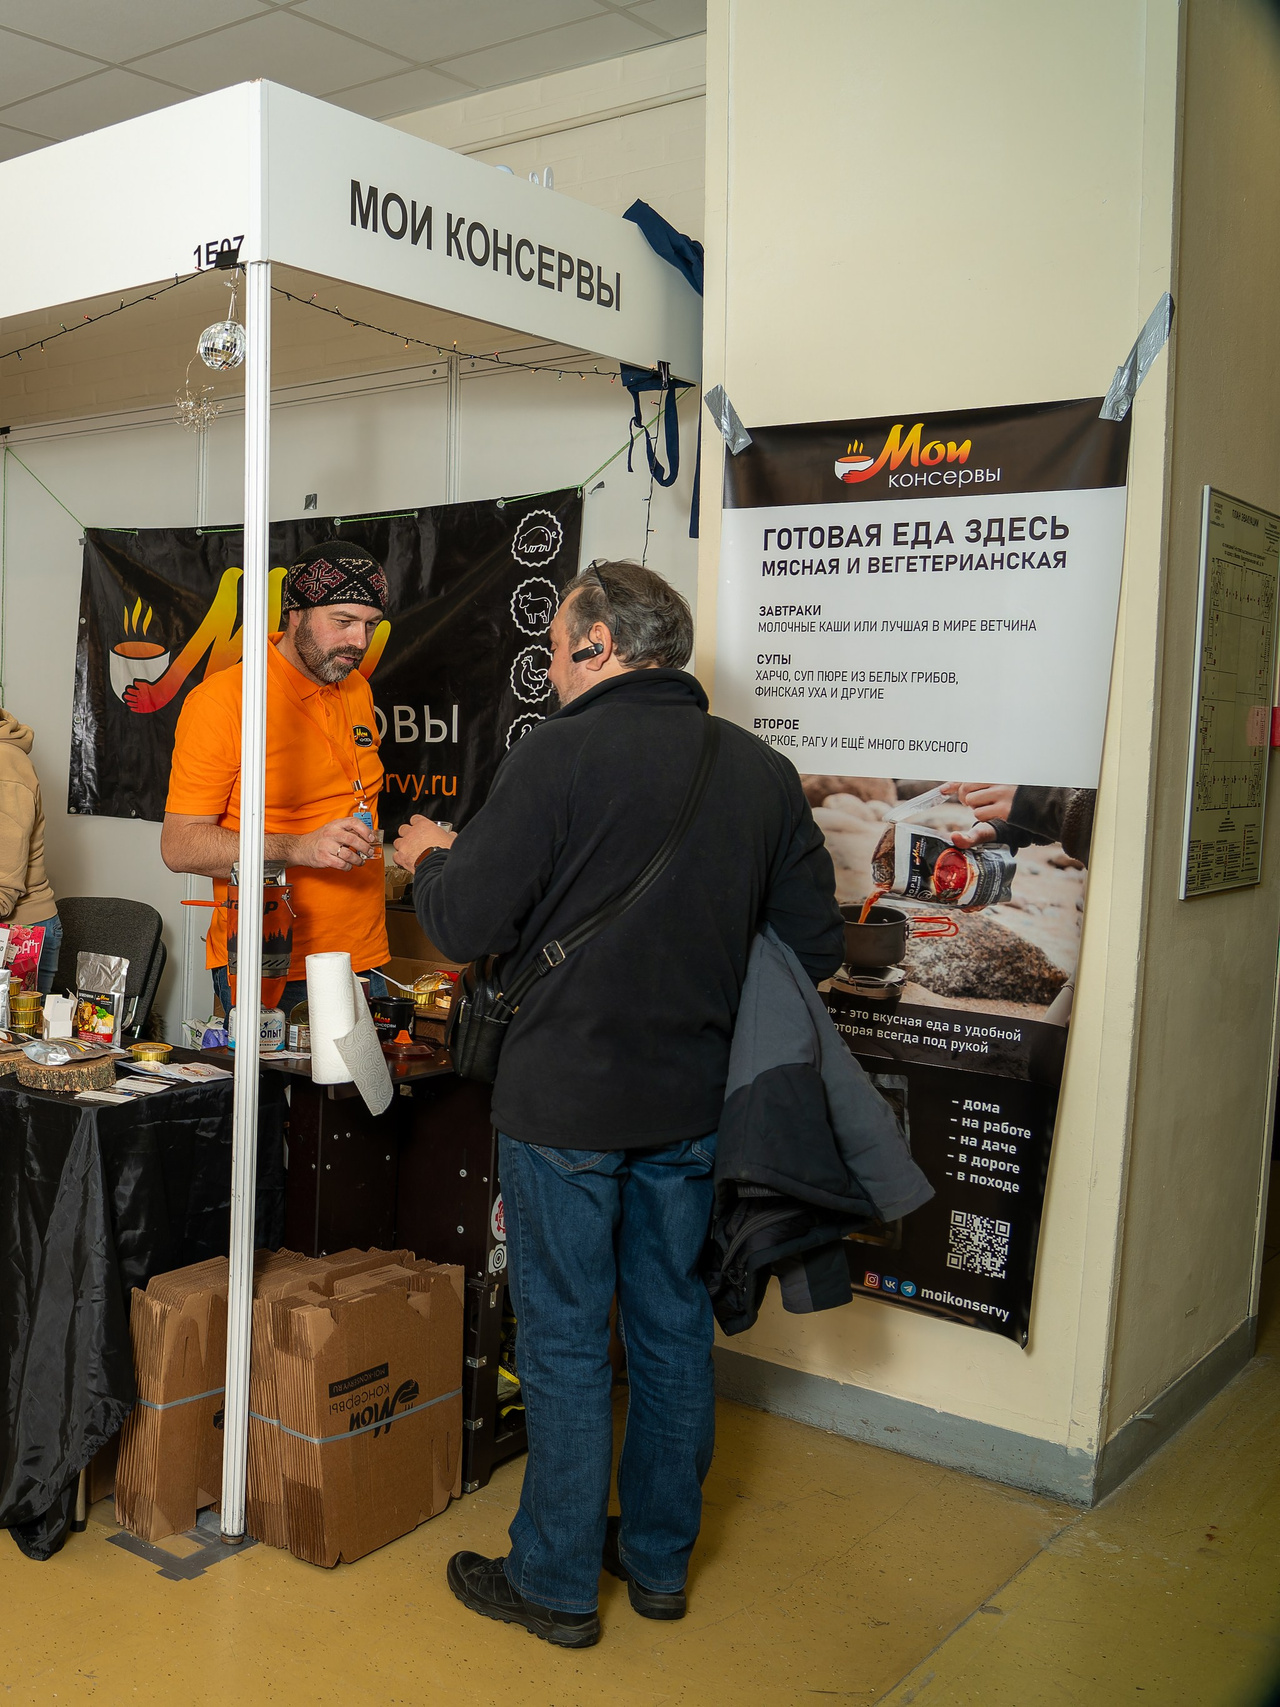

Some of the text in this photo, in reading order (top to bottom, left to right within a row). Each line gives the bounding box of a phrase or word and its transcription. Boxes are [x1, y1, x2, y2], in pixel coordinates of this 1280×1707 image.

[193, 234, 245, 268] 1E07
[350, 179, 621, 312] МОИ КОНСЕРВЫ
[875, 423, 972, 473] Мои
[889, 468, 1001, 488] консервы
[763, 515, 1070, 551] ГОТОВАЯ ЕДА ЗДЕСЬ
[761, 550, 1067, 577] МЯСНАЯ И ВЕГЕТЕРИАНСКАЯ
[758, 604, 822, 617] ЗАВТРАКИ
[758, 620, 1038, 633] МОЛОЧНЫЕ КАШИ ИЛИ ЛУЧШАЯ В МИРЕ ВЕТЧИНА
[756, 653, 791, 665] СУПЫ
[755, 670, 959, 685] ХАРЧО, СУП ПЮРЕ ИЗ БЕЛЫХ ГРИБОВ,
[755, 686, 885, 700] ФИНСКАЯ УХА И ДРУГИЕ
[753, 718, 800, 730] ВТОРОЕ
[802, 735, 827, 748] РАГУ
[830, 737, 838, 748] И
[841, 735, 865, 751] ЕЩЁ
[868, 738, 905, 751] МНОГО
[908, 740, 969, 753] ВКУСНОГО
[385, 773, 458, 802] rvy.ru
[849, 1009, 869, 1020] это
[873, 1012, 922, 1028] вкусная
[926, 1020, 949, 1033] еда
[953, 1022, 962, 1033] в
[965, 1023, 1021, 1042] удобной
[833, 1022, 989, 1054] оторая всегда под рукой
[962, 1099, 1001, 1114] дома
[961, 1116, 979, 1129] на
[983, 1120, 1031, 1139] работе
[960, 1134, 977, 1147] на
[981, 1139, 1017, 1155] даче
[958, 1153, 967, 1163] в
[971, 1156, 1020, 1174] дороге
[956, 1171, 965, 1181] в
[969, 1173, 1020, 1193] походе
[921, 1287, 1010, 1322] moikonservy
[329, 1383, 391, 1416] консервы
